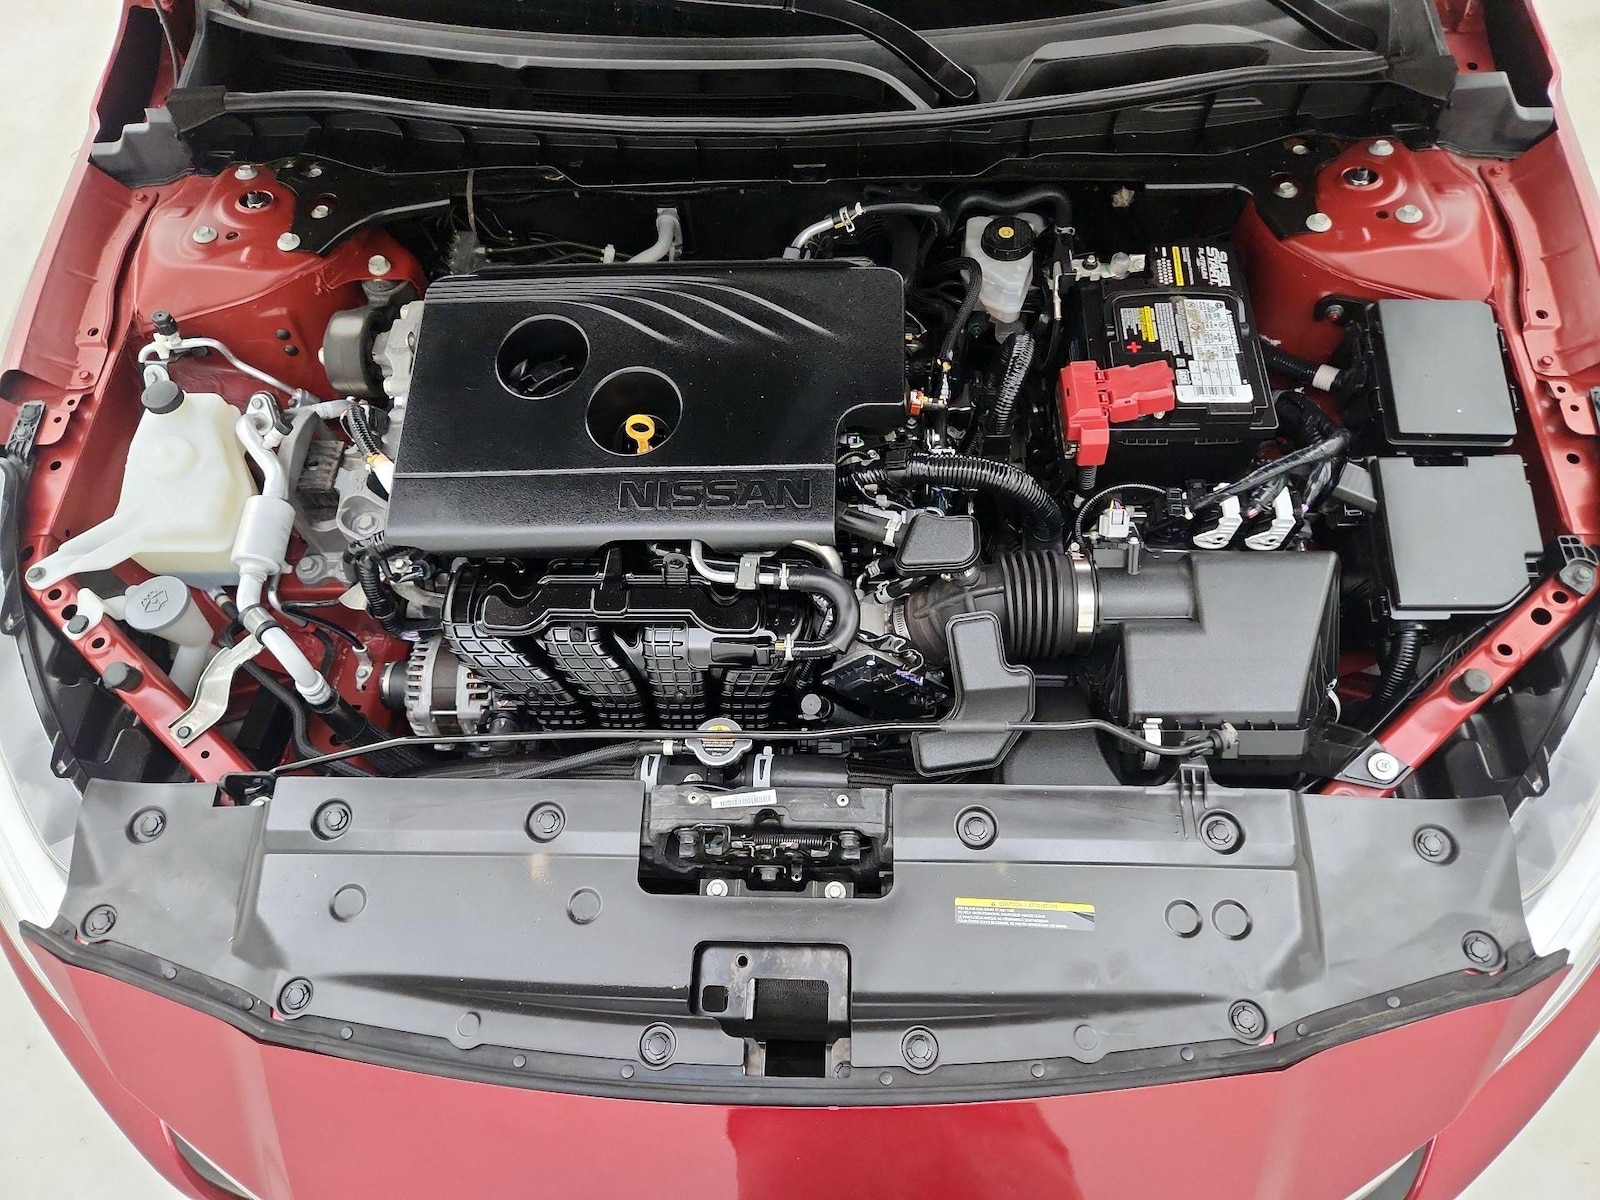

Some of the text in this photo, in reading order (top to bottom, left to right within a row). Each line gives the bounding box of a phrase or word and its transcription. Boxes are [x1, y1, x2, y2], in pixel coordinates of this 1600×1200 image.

[1198, 247, 1209, 280] PLATINUM
[1205, 246, 1220, 286] START
[1217, 250, 1231, 287] SUPER
[617, 478, 812, 511] NISSAN
